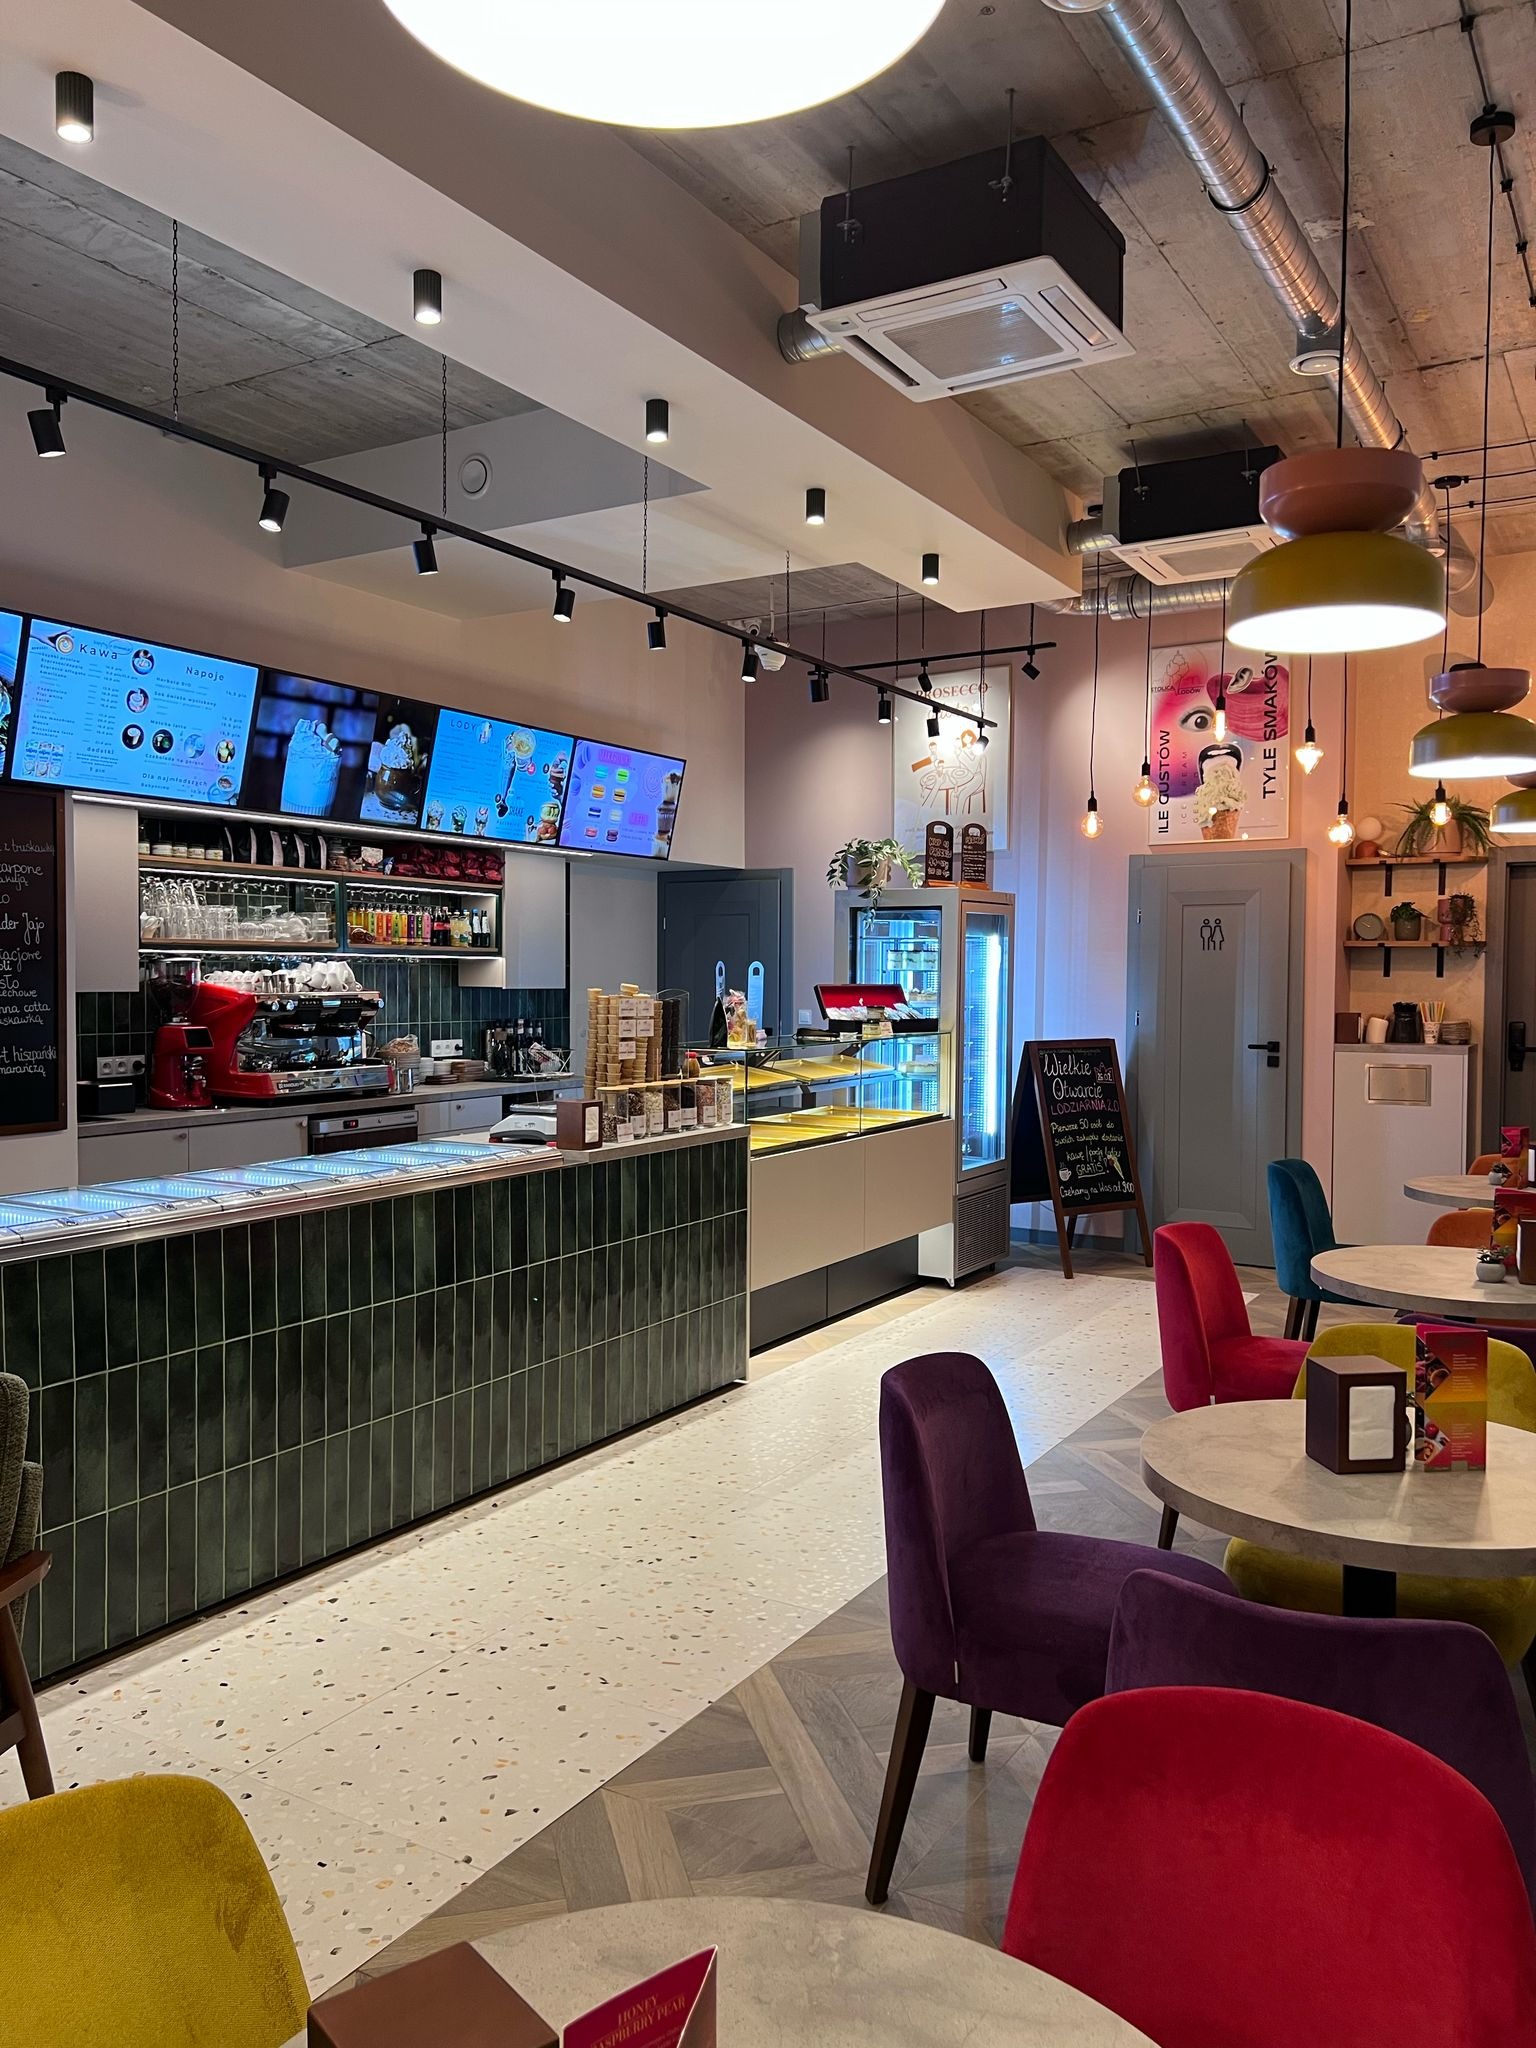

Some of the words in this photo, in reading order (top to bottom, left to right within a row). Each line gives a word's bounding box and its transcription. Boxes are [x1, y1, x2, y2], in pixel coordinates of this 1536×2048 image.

[79, 643, 118, 660] Kawa
[186, 666, 225, 681] Napoje
[450, 720, 476, 731] LODY
[1157, 730, 1170, 805] GUSTÓW
[1262, 748, 1276, 799] TYLE
[1158, 810, 1169, 833] ILE
[0, 913, 19, 930] der
[22, 912, 45, 945] Jajo
[24, 1001, 51, 1012] cotta
[1044, 1053, 1092, 1076] Wielkie
[1052, 1077, 1103, 1100] Otwarcie
[1051, 1099, 1107, 1116] LODZIARNIA
[1079, 1118, 1089, 1130] 50
[1106, 1121, 1114, 1129] do
